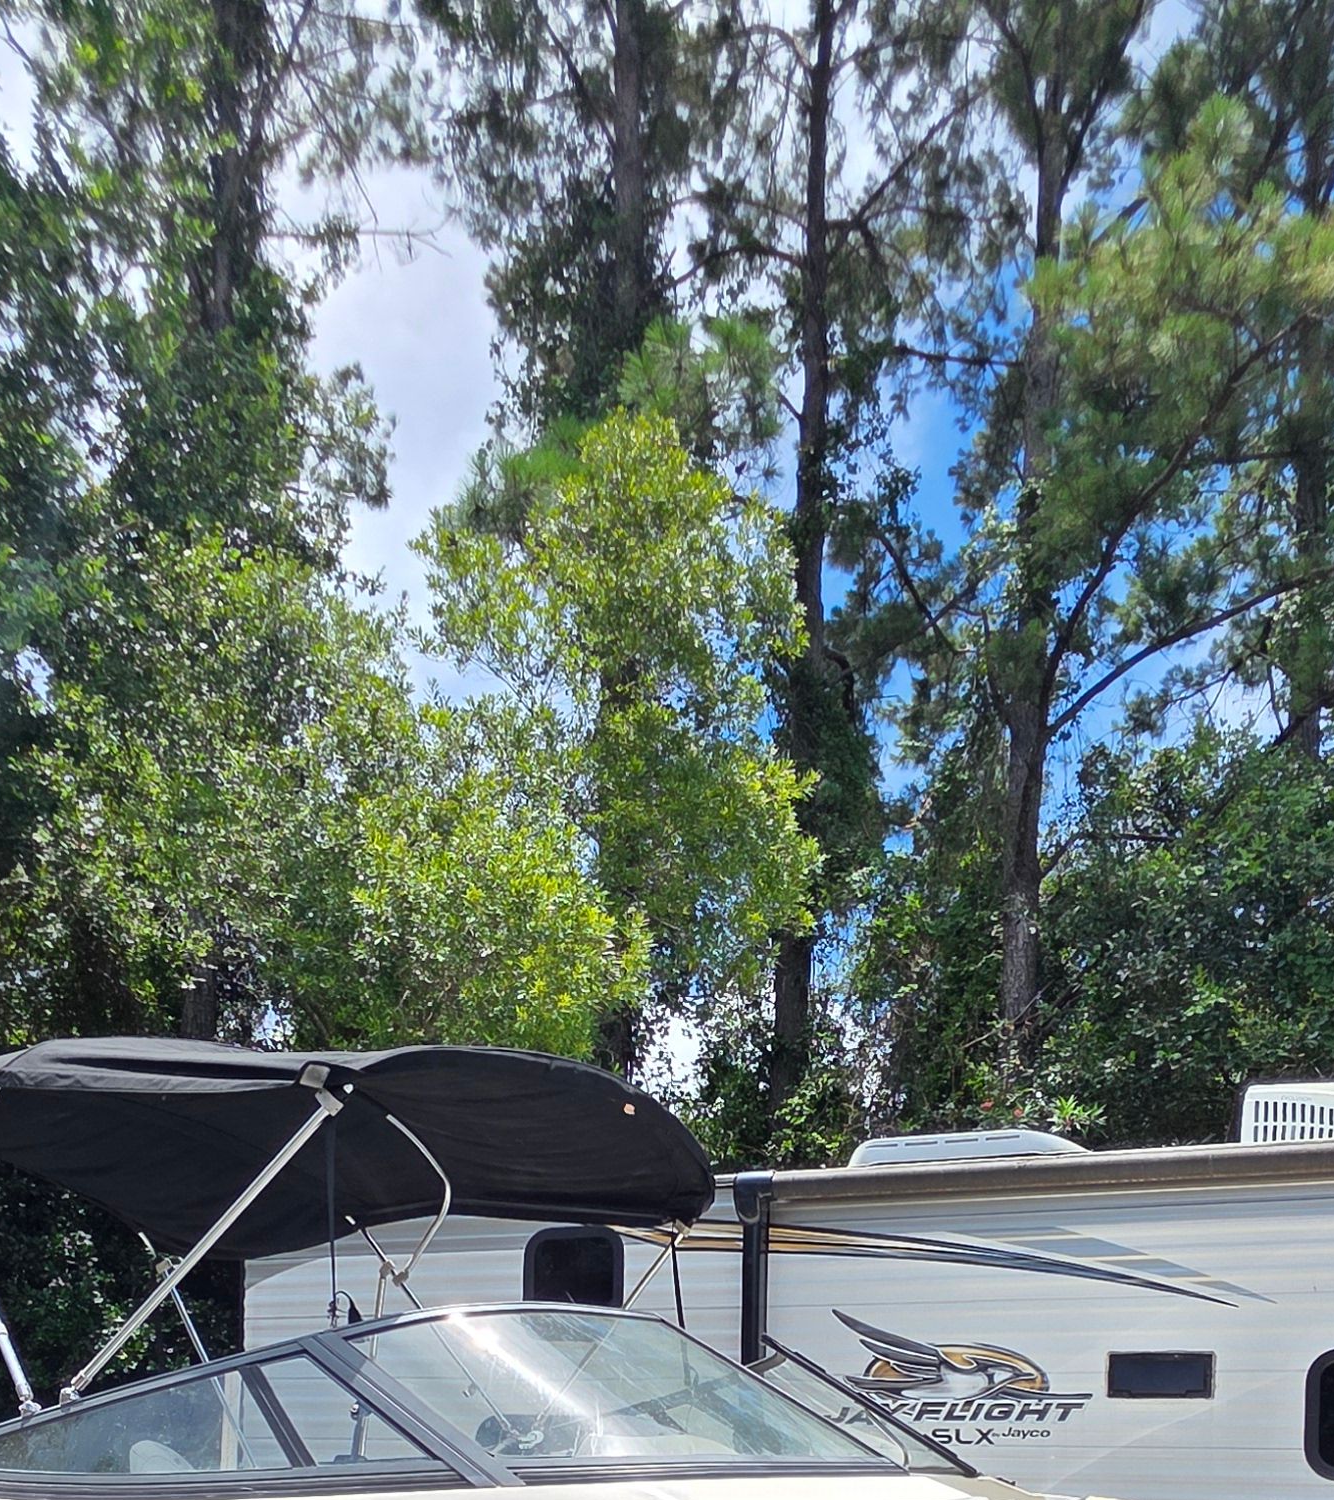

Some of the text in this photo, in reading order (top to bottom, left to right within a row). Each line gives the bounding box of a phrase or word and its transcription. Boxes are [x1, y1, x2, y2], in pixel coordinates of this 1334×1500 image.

[913, 1402, 1085, 1422] FLIGHT
[931, 1427, 1051, 1445] SLX Jayco
